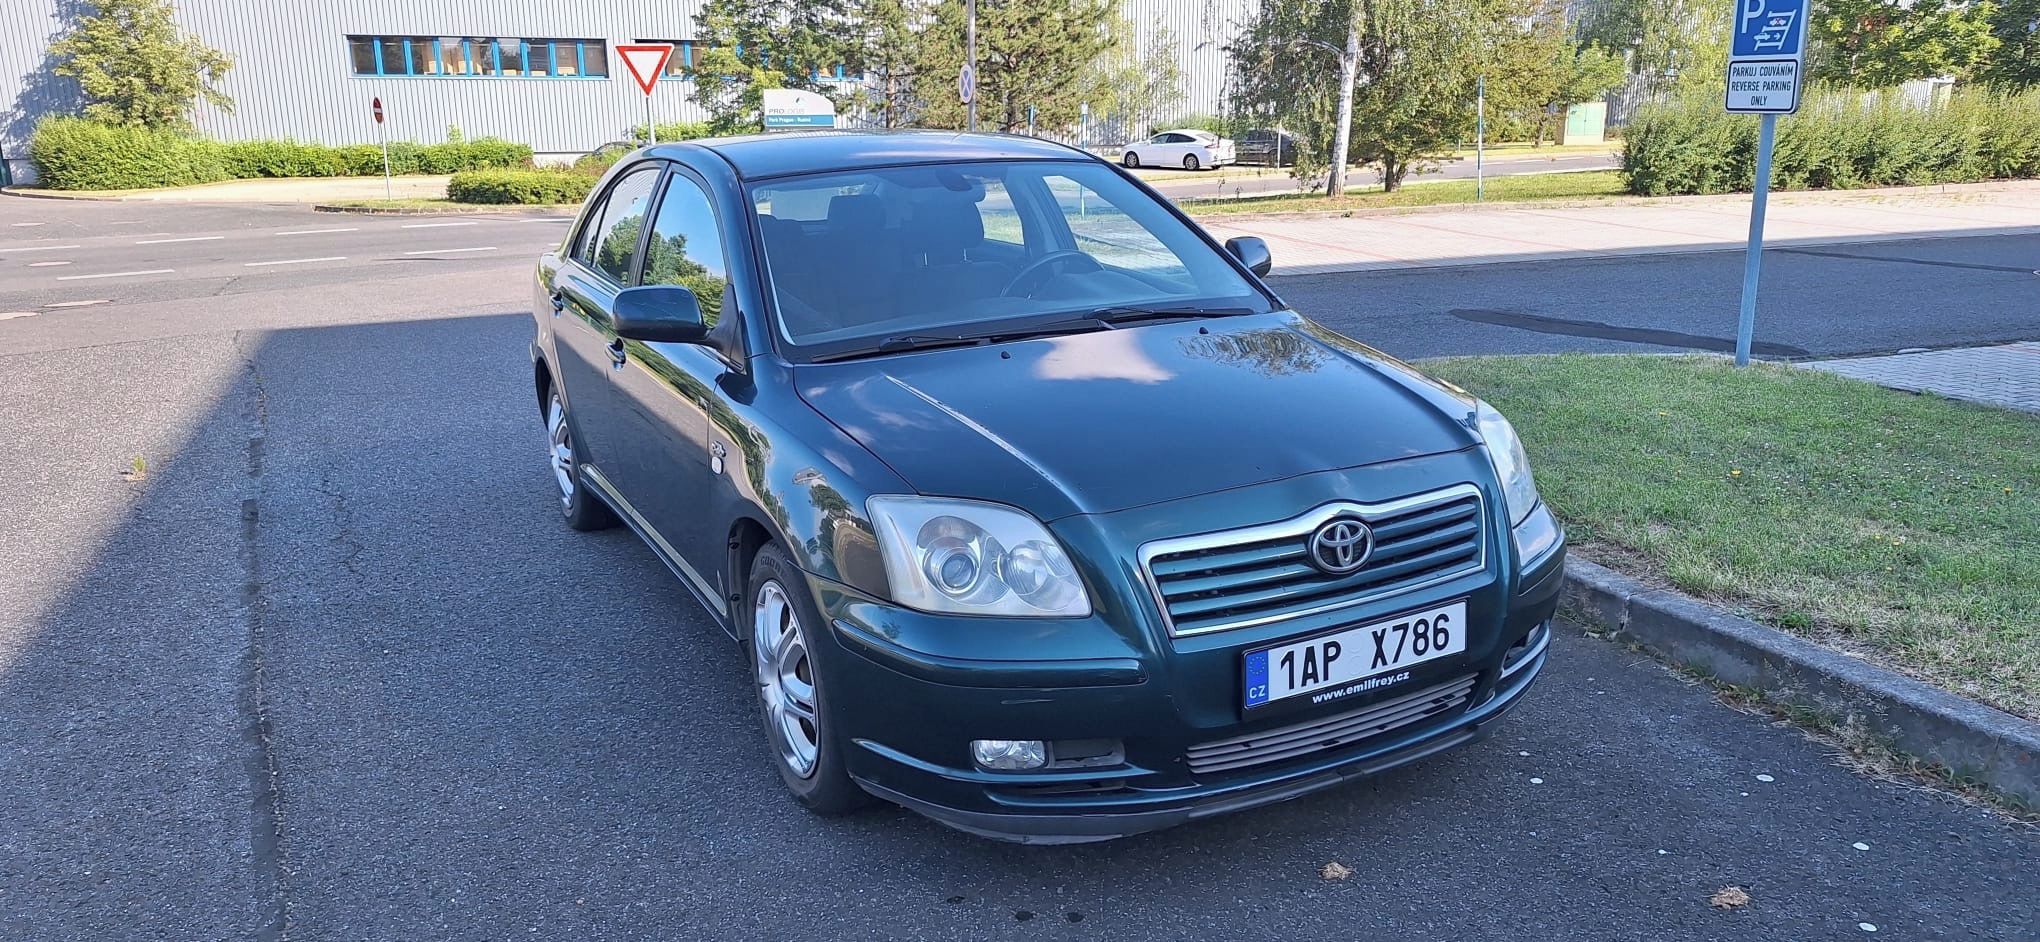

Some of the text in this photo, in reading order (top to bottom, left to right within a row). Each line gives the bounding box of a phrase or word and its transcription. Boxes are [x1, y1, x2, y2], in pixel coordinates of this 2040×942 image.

[1741, 0, 1766, 34] P
[1732, 64, 1794, 77] PARKUJ COUVÁNÍM
[1731, 80, 1791, 92] REVERSE PARKING
[1750, 95, 1768, 106] ONLY
[1280, 613, 1450, 690] 1AP X786
[1249, 684, 1266, 699] CZ
[1312, 671, 1410, 704] www.emilfrey.cz
